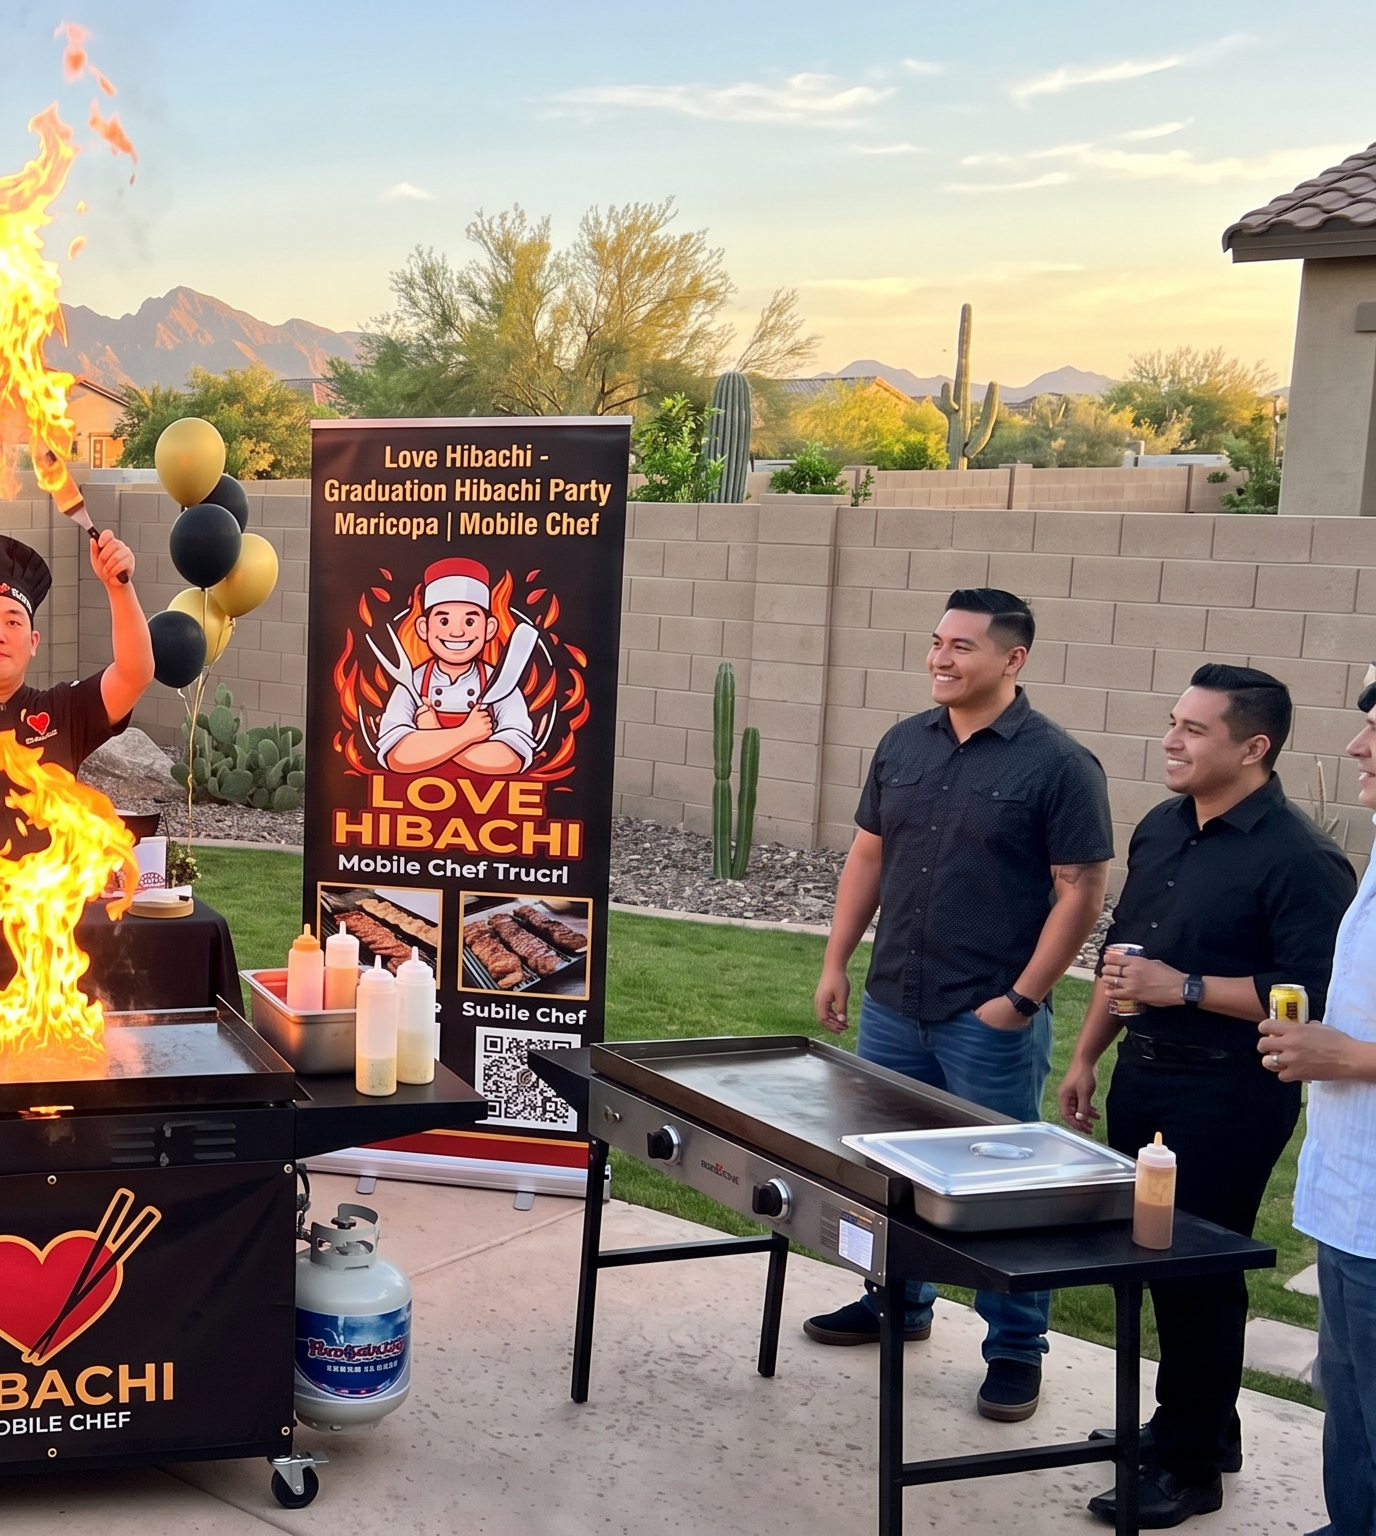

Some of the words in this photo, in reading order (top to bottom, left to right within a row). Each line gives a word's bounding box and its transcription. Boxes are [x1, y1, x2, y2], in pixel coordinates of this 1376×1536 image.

[385, 445, 438, 469] Love
[446, 444, 533, 468] Hibachi
[324, 478, 447, 503] Graduation
[455, 478, 541, 502] Hibachi
[549, 478, 612, 506] Party
[334, 511, 439, 540] Maricopa
[459, 511, 538, 536] Mobile
[545, 512, 599, 536] Chef
[371, 776, 543, 817] LOVE
[335, 811, 581, 857] HIBACHI
[338, 853, 421, 875] Mobile
[427, 859, 488, 879] Chef
[461, 1001, 530, 1021] Subile
[536, 1007, 588, 1025] Chef
[68, 1410, 131, 1432] CHEF
